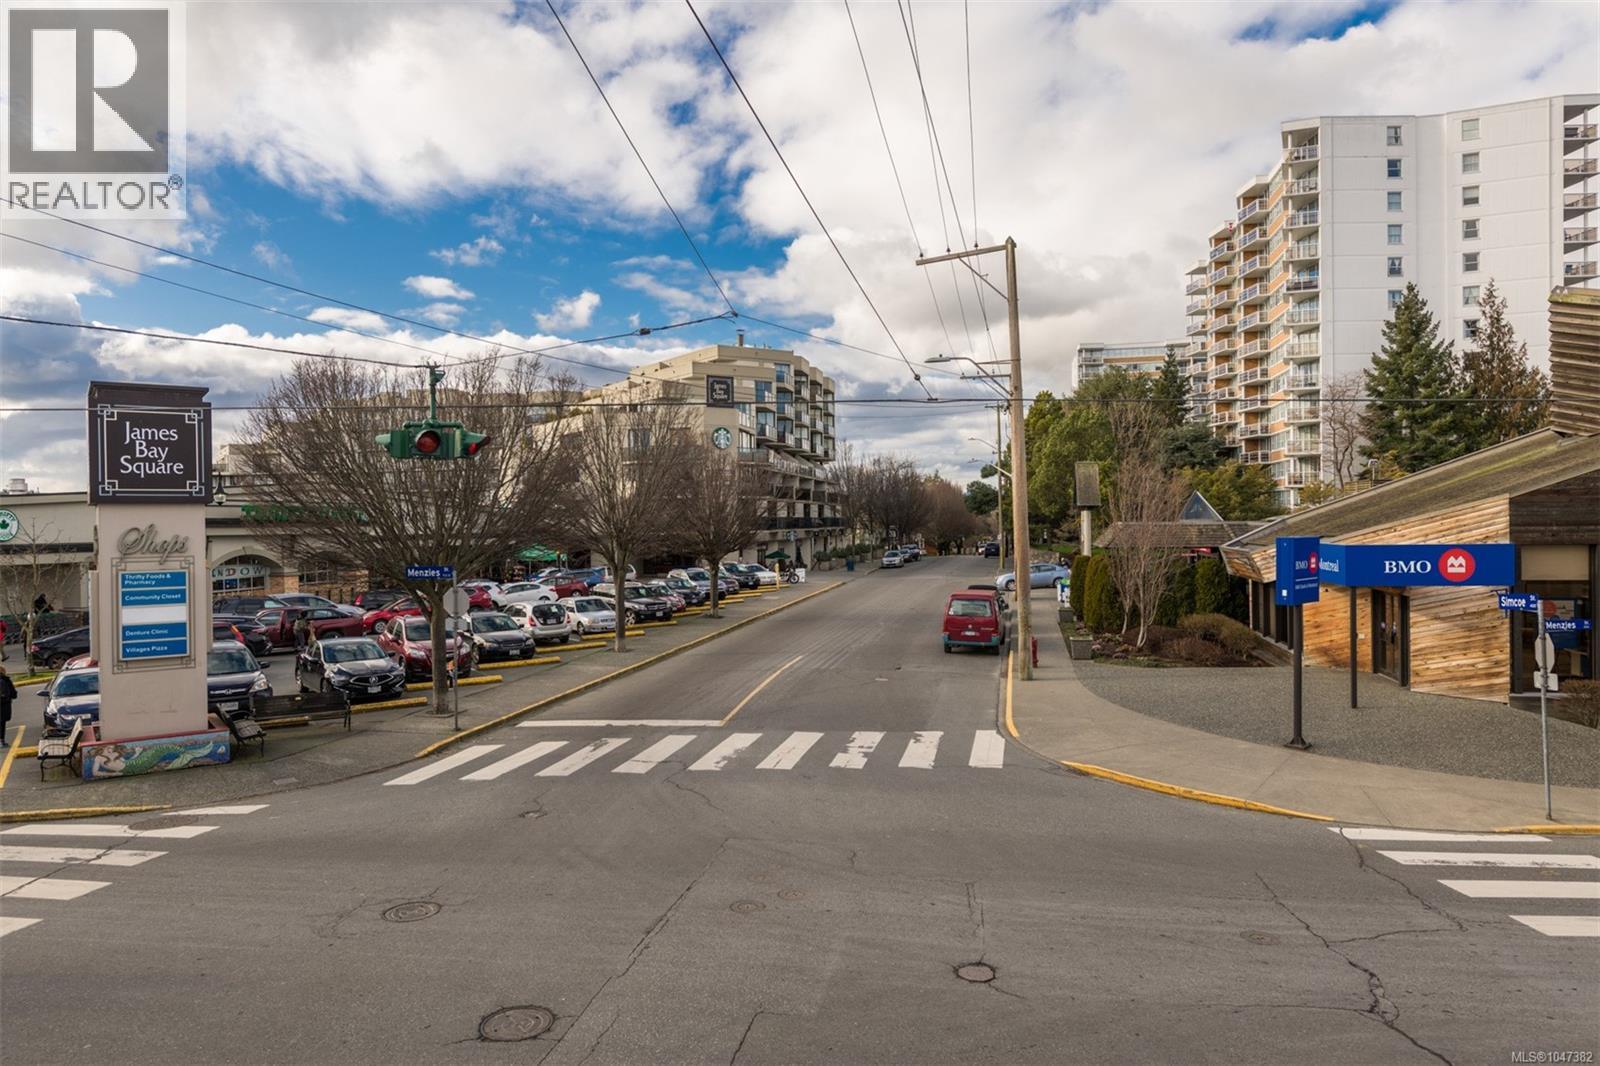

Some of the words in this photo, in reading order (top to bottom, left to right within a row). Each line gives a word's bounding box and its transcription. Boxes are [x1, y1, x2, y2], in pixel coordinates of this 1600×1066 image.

[124, 421, 178, 445] James
[135, 440, 169, 462] Bay
[120, 455, 184, 478] Square
[118, 523, 189, 565] Shops
[407, 568, 440, 577] Menzies
[1383, 560, 1432, 574] BMO
[1501, 596, 1527, 607] Simcoe
[1545, 621, 1577, 630] Menzies
